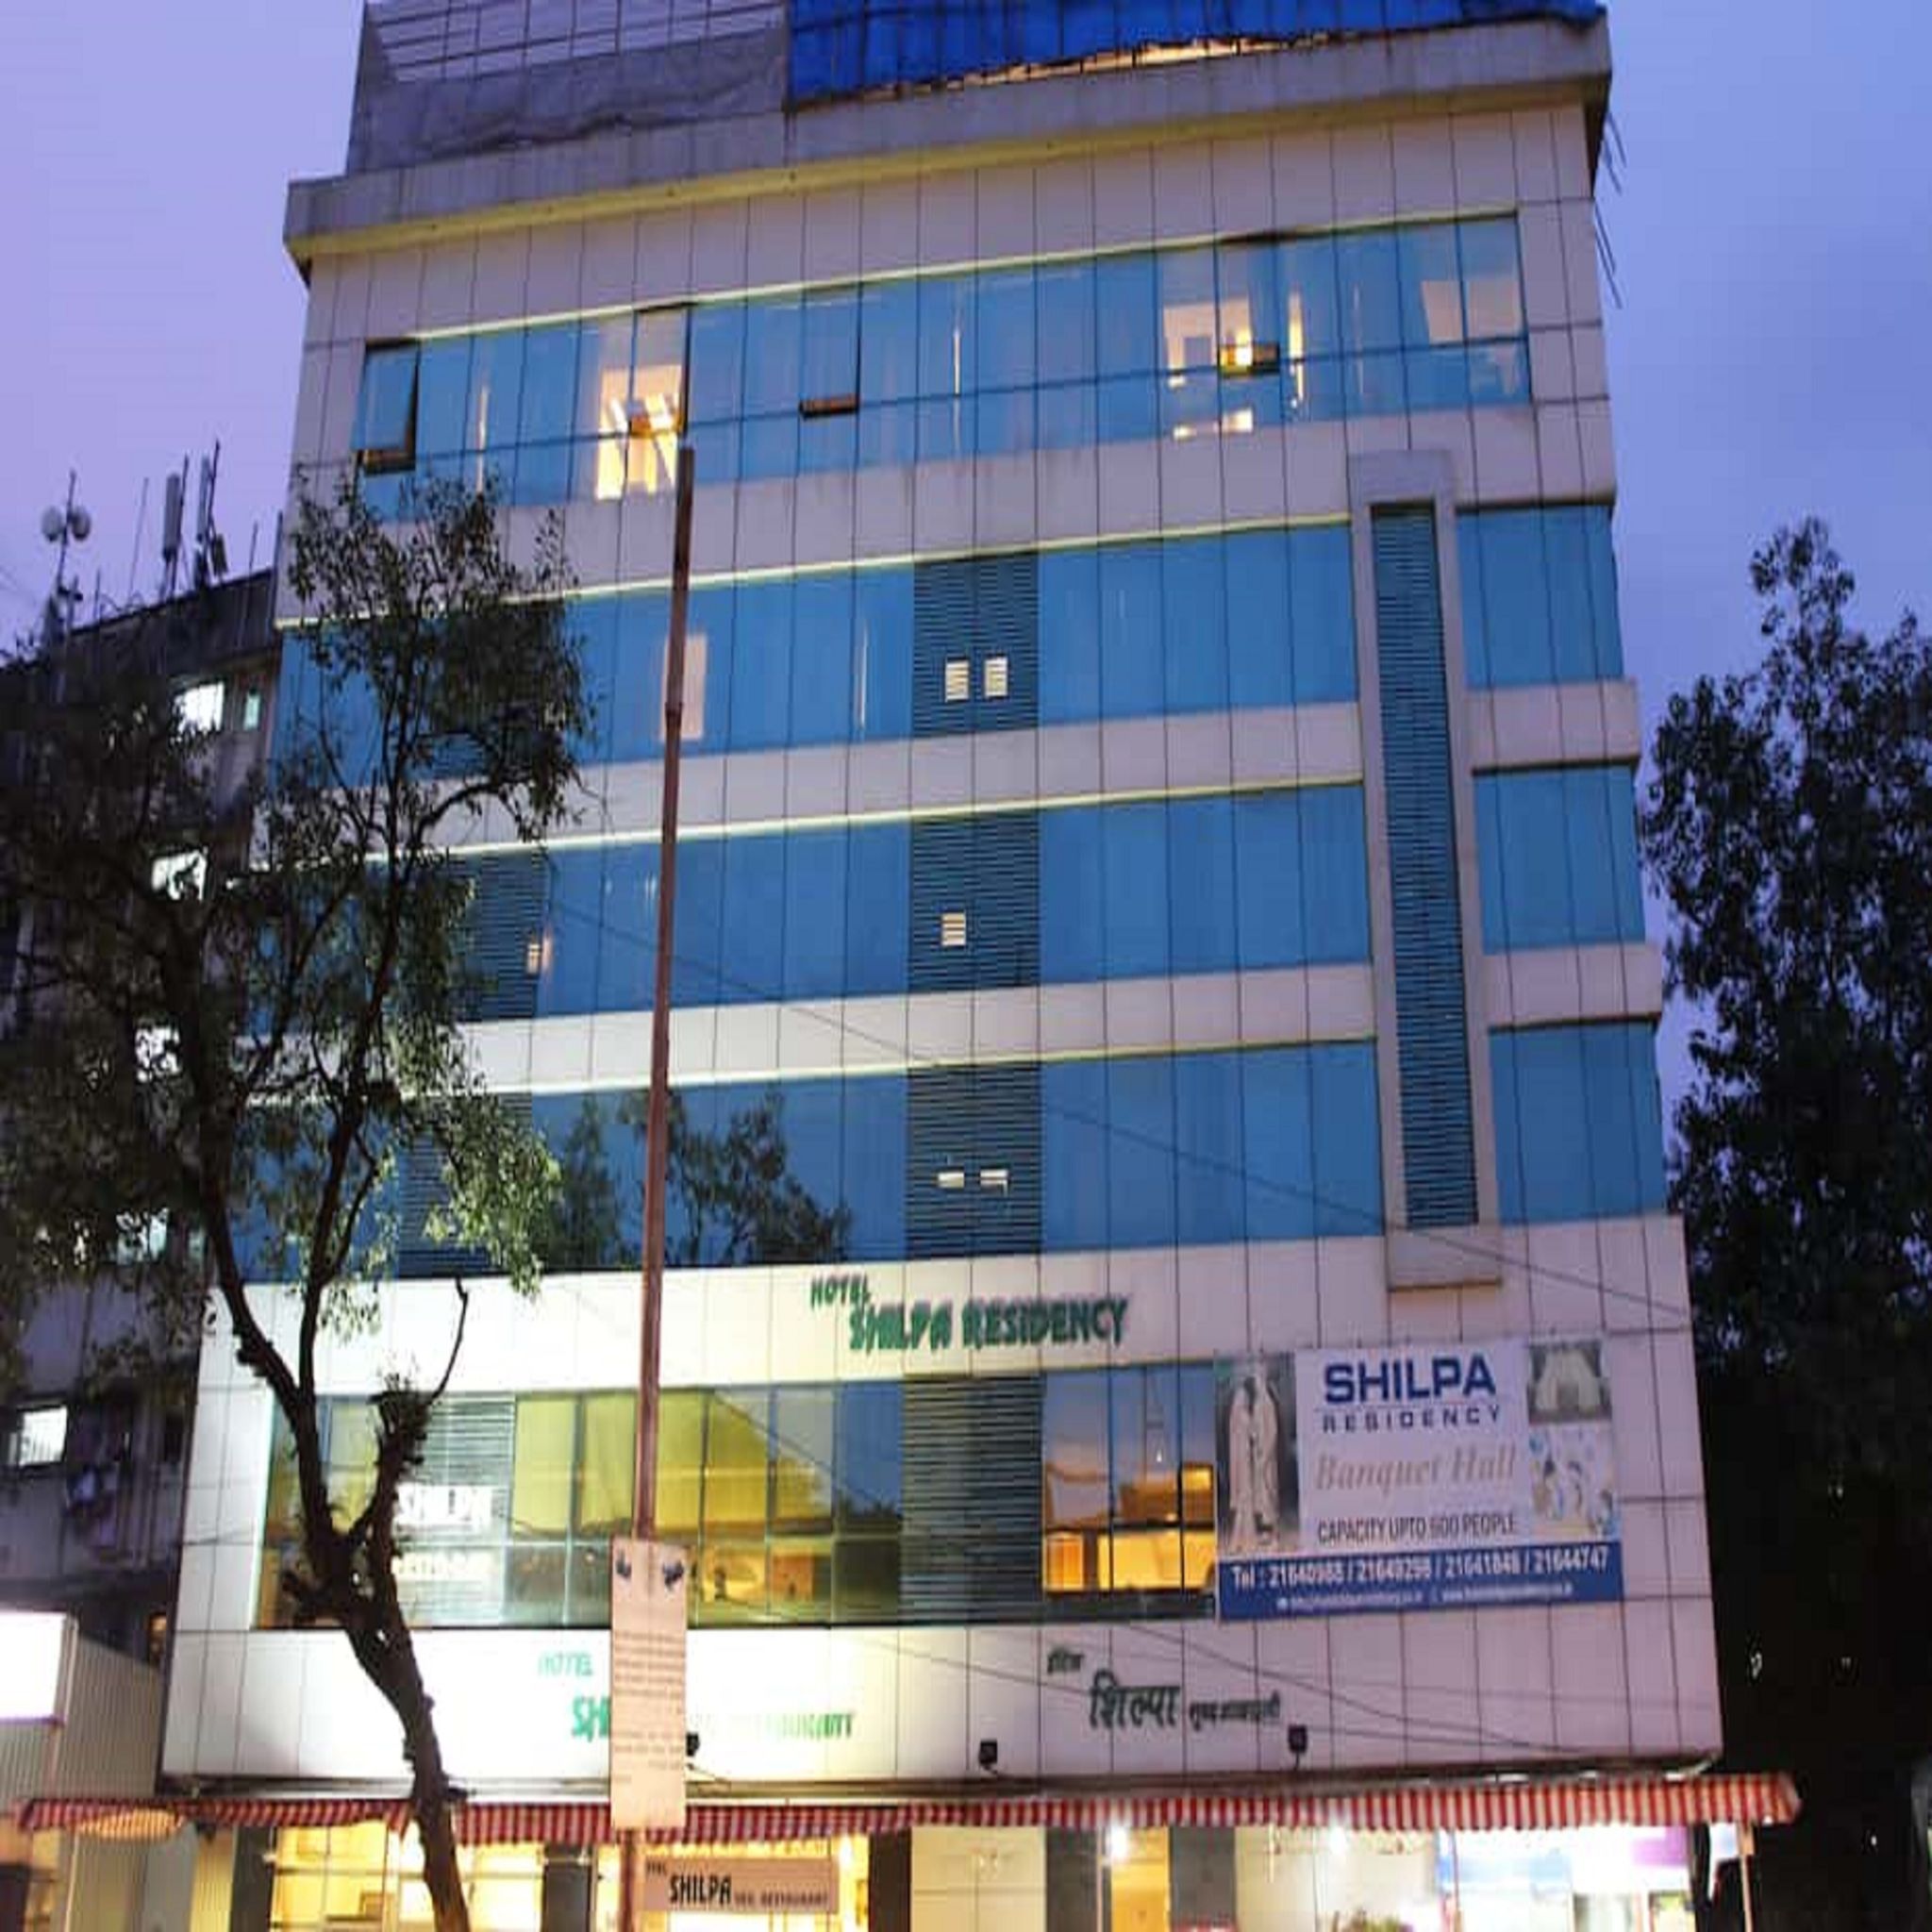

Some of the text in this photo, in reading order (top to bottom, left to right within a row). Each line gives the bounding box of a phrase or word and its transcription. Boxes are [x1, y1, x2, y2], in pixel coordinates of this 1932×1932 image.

[810, 1274, 873, 1308] HOTEL
[849, 1296, 1130, 1354] SHILPA RESIDENCY
[1324, 1353, 1497, 1405] SHILPA
[1323, 1404, 1500, 1433] RESIDENCY
[1315, 1441, 1517, 1496] Banquet Hall
[1317, 1516, 1385, 1543] CAPACITY
[1389, 1515, 1426, 1541] UPTO
[1462, 1511, 1516, 1537] PEOPLE
[669, 1873, 732, 1905] SHILPA
